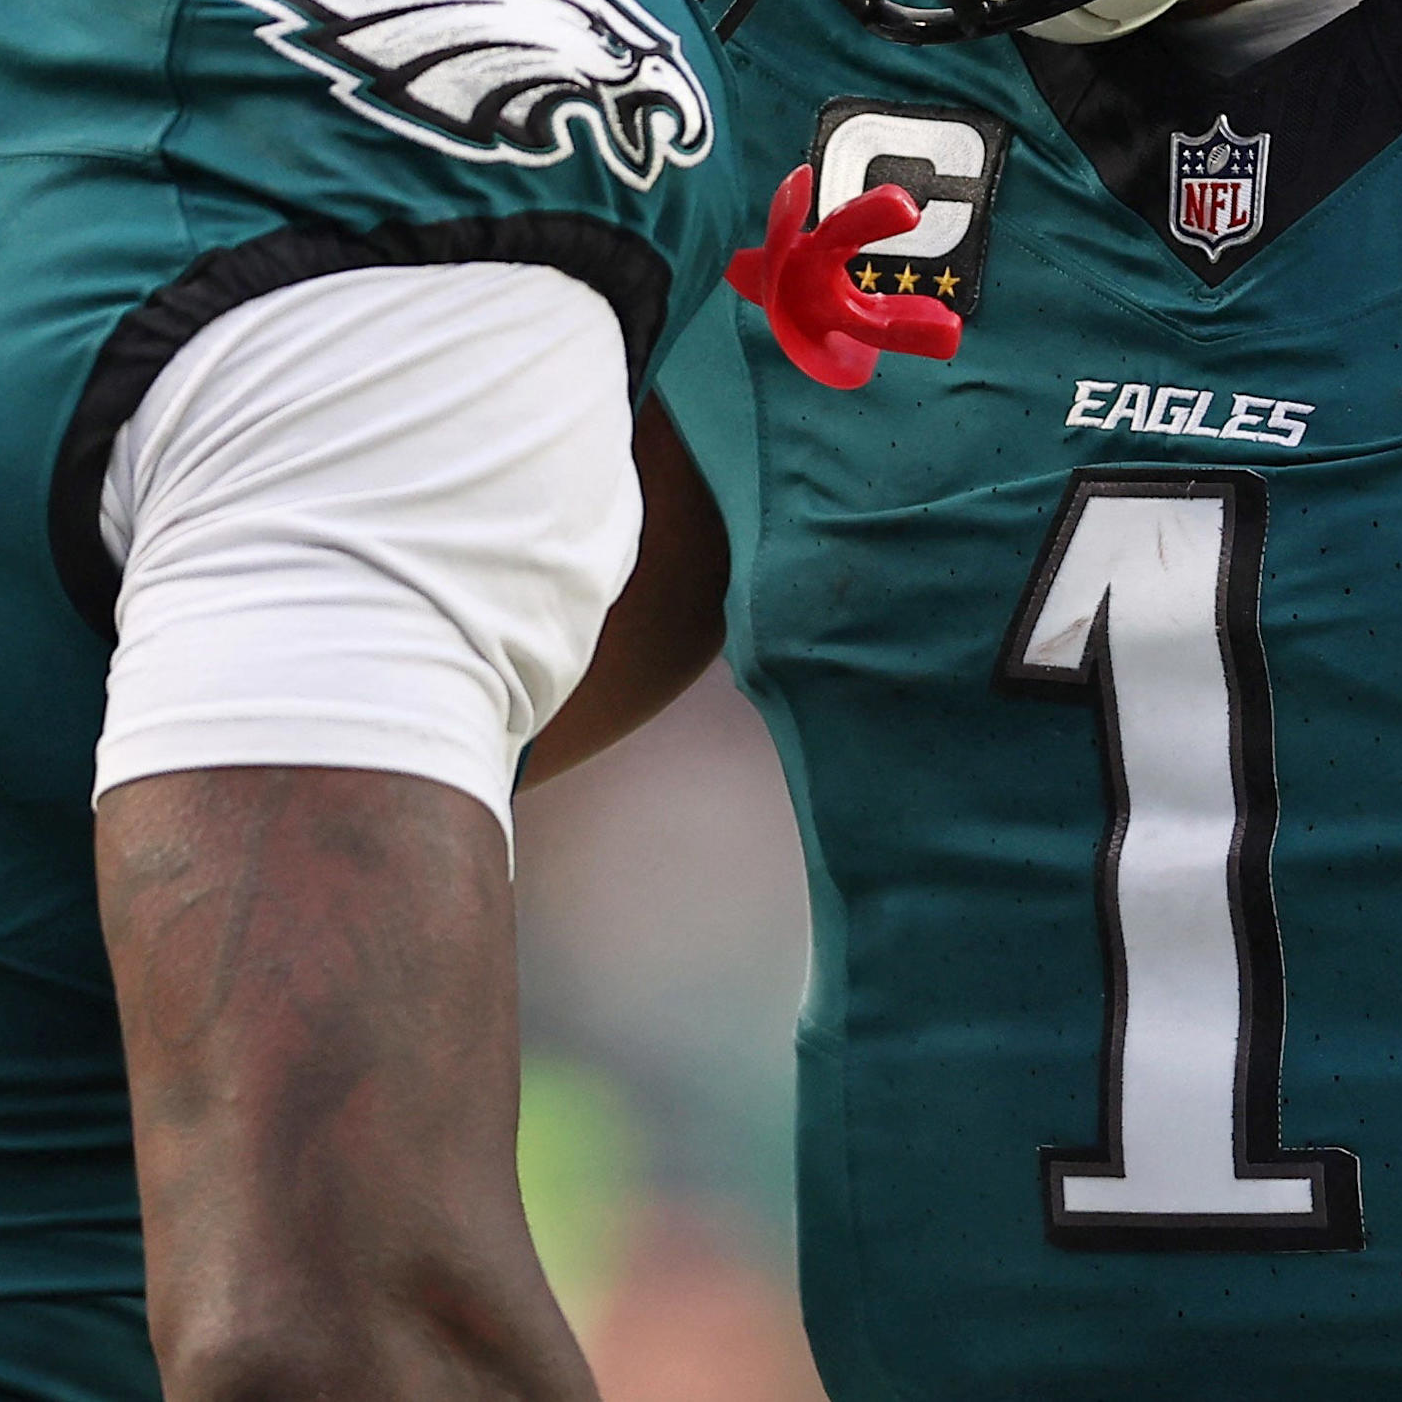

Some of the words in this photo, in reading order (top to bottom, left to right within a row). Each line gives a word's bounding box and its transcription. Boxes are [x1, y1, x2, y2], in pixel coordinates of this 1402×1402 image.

[817, 112, 986, 258] C
[1183, 182, 1248, 235] NFL
[1065, 379, 1317, 447] EAGLES
[1000, 466, 1367, 1252] 1
